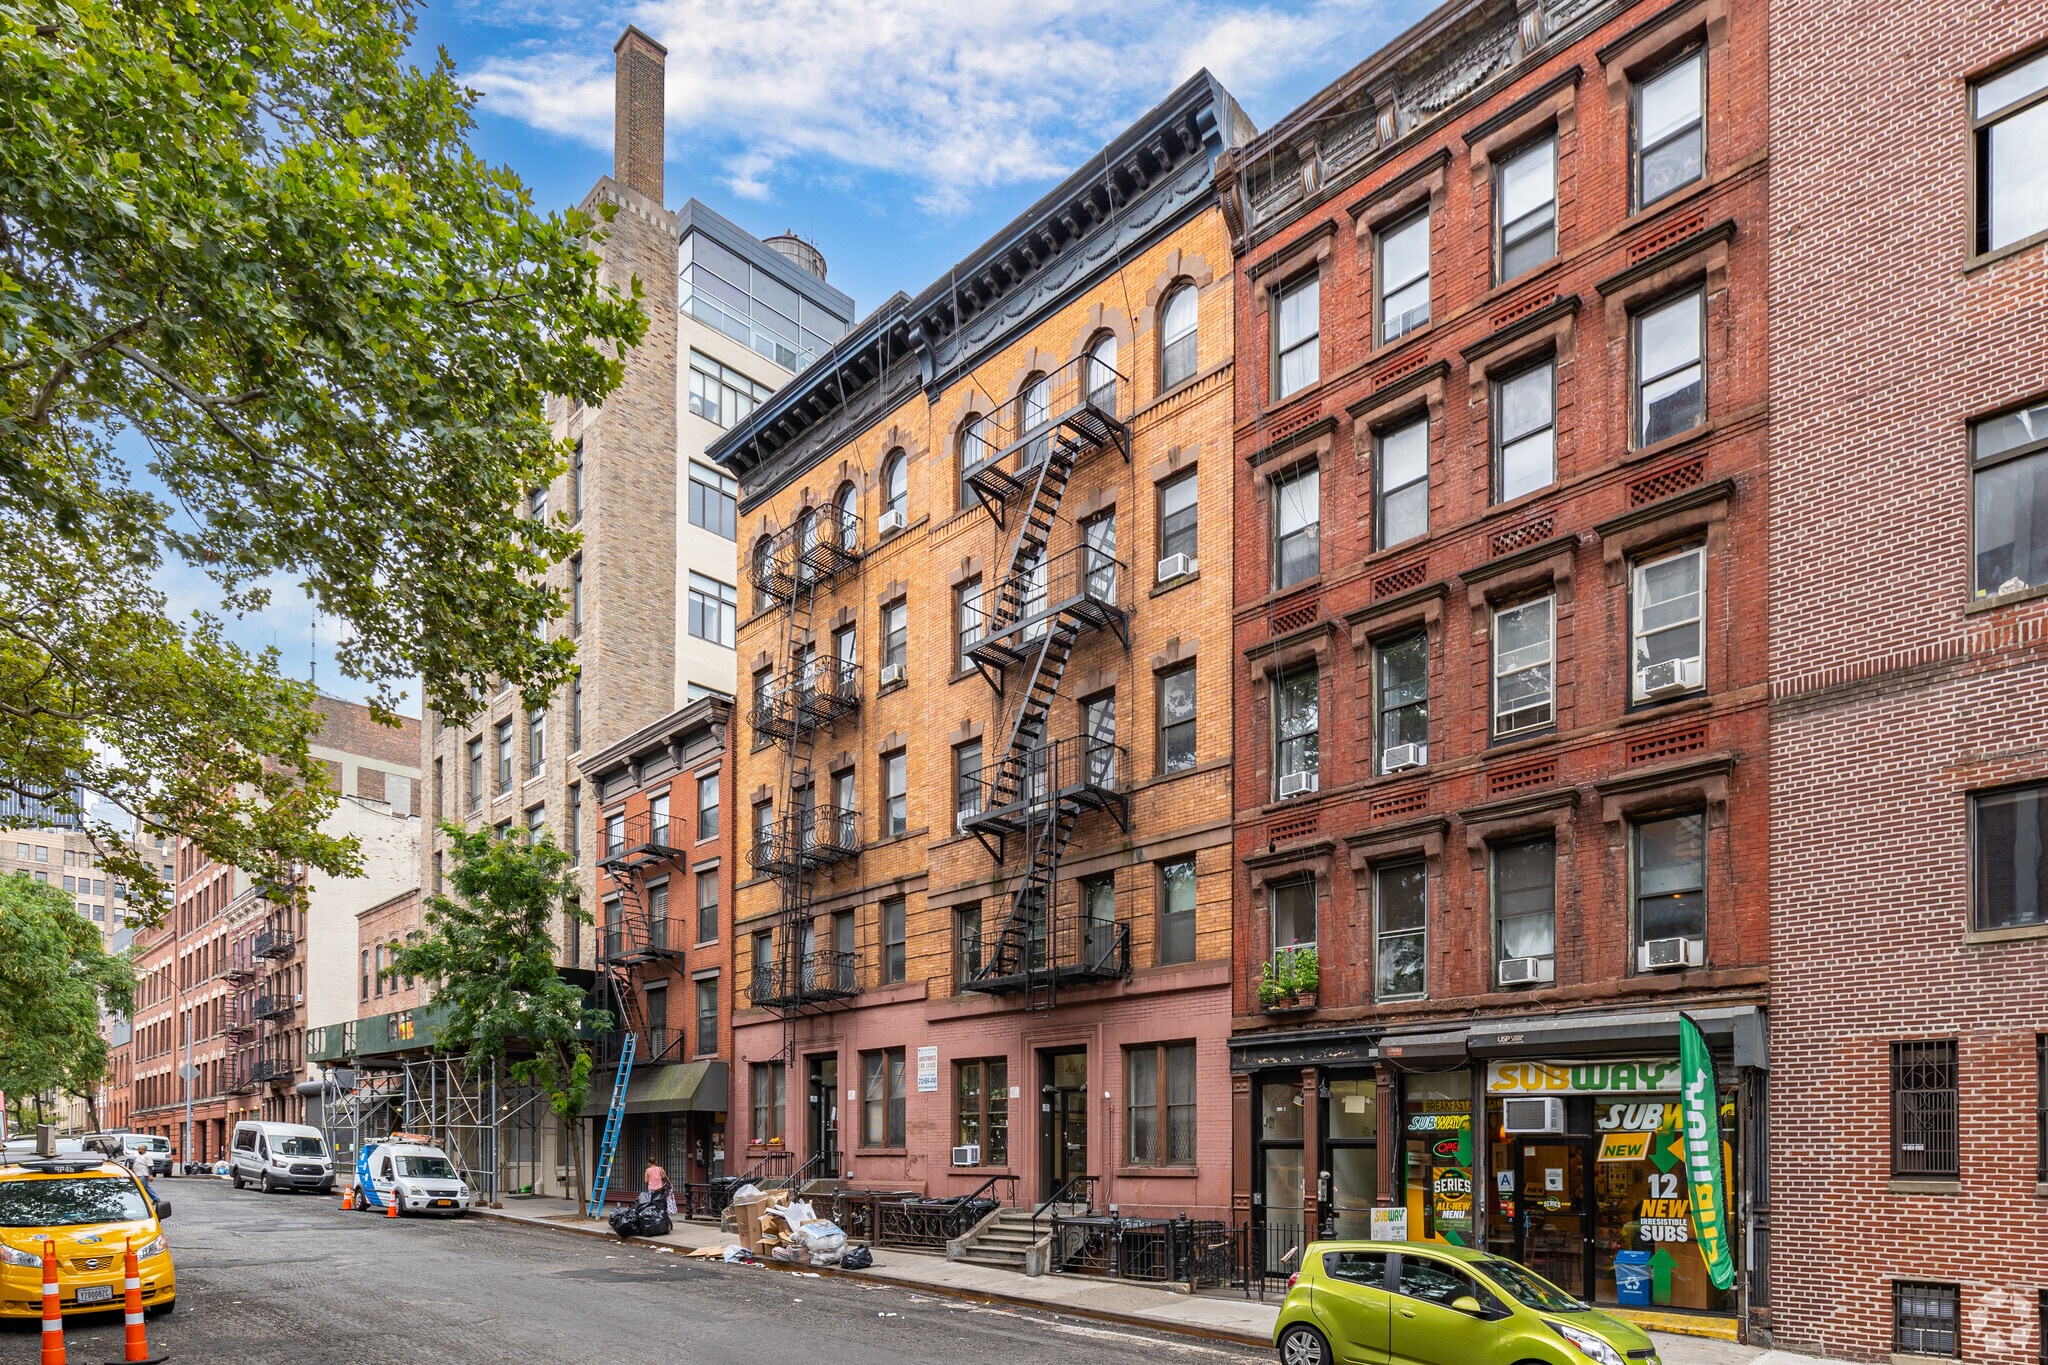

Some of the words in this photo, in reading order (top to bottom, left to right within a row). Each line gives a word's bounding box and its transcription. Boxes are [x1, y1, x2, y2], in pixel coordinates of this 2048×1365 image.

[1490, 1061, 1680, 1091] SUBWAY
[1426, 1101, 1468, 1112] BREAKFAST
[1407, 1114, 1470, 1131] SUBWAY
[1437, 1142, 1459, 1153] OPE
[1604, 1144, 1642, 1157] NEW
[1434, 1178, 1471, 1193] SERIES
[1500, 1174, 1511, 1186] A
[1647, 1173, 1678, 1199] 12
[1436, 1202, 1471, 1211] ALL-NEW
[1640, 1199, 1689, 1218] NEW
[1374, 1209, 1405, 1223] SUBWAY
[1441, 1210, 1466, 1219] MENU
[1640, 1218, 1687, 1226] IRRESISTIBLE
[1640, 1225, 1688, 1243] SUBS
